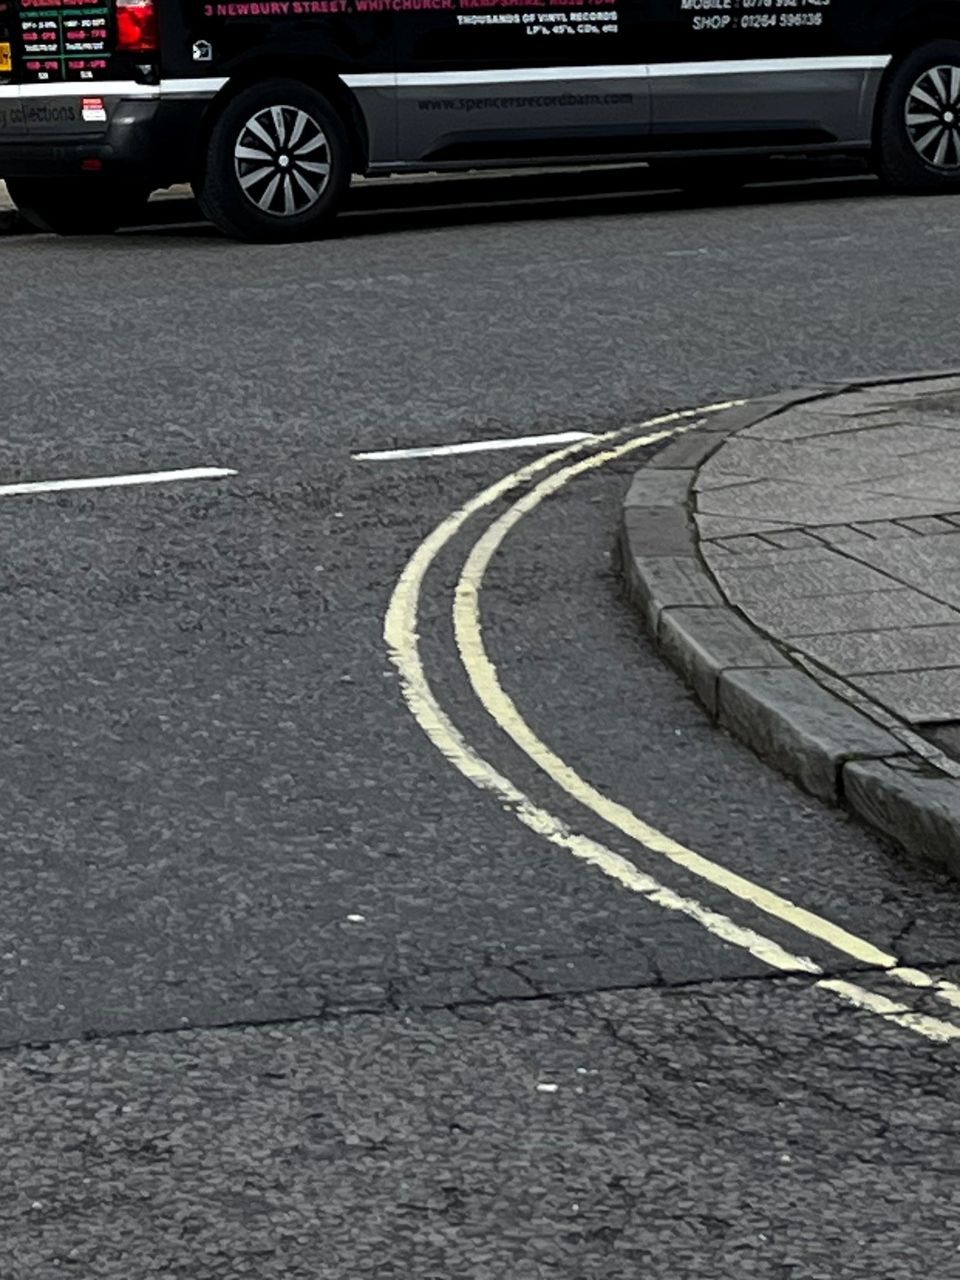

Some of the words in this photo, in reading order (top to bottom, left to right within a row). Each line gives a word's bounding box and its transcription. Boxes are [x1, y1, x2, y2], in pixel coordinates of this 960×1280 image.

[204, 4, 213, 16] 3
[217, 2, 290, 16] NEWBURY
[292, 0, 353, 14] STREET,
[570, 11, 618, 21] RECORDS
[692, 14, 731, 30] SHOP
